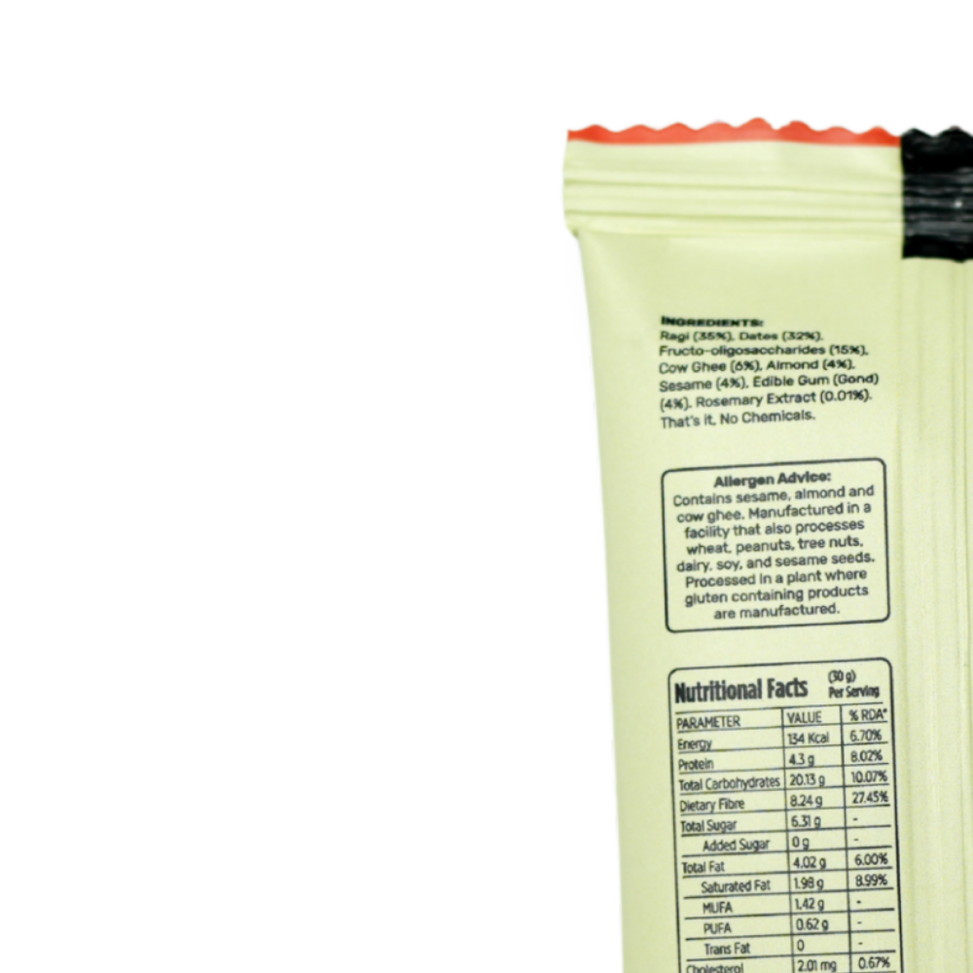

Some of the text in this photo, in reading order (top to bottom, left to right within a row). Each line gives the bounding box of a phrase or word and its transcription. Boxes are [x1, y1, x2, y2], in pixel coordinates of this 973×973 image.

[660, 331, 778, 343] Ragi Dates
[659, 345, 825, 357] Fructo-oligosaccharides
[659, 360, 818, 374] Cow Ghee Almond
[659, 373, 879, 392] Sesame Edible Gum (Gond)
[696, 394, 763, 408] Rosemary
[767, 392, 817, 404] Extract
[661, 410, 816, 428] That's No Chemicals.
[714, 472, 831, 489] Allergen Advice:
[673, 492, 732, 507] Contains
[795, 487, 845, 499] almond
[849, 485, 874, 497] and
[677, 512, 703, 523] cow
[749, 502, 844, 519] Manufactured
[847, 502, 859, 514] in
[863, 503, 871, 513] a
[684, 520, 865, 539] facility that also processes
[798, 538, 825, 549] tree
[747, 556, 771, 569] and
[775, 555, 828, 567] sesame
[686, 569, 867, 588] Processed in a plant where
[685, 585, 869, 607] gluten containing products
[714, 609, 735, 620] are
[828, 669, 856, 683] (30 g)
[674, 677, 808, 703] Nutritional Facts
[828, 685, 880, 698] Per Serving
[676, 715, 741, 730] PARAMETER
[787, 711, 822, 724] VALUE
[678, 730, 882, 750] Energy 134 Kcal 6.70%
[678, 750, 883, 771] Protein 4.3 8.02%
[679, 771, 888, 791] Total Carbohydrates 20.13 10.07%
[680, 791, 889, 813] Dietary Fibre 8.24 27.45%
[681, 820, 705, 833] Total
[707, 818, 737, 831] Sugar
[703, 838, 770, 852] Added Sugar
[682, 853, 888, 874] Total Fat 4.02 6.00%
[701, 874, 888, 893] Saturated Fat 1.98 8.99%
[703, 898, 815, 914] MUFA 1.42
[704, 918, 819, 934] PUFA 0.62
[704, 943, 751, 955] Trans Fat
[797, 961, 818, 972] 2.01
[821, 961, 837, 972] mg
[858, 957, 890, 969] 0.67%
